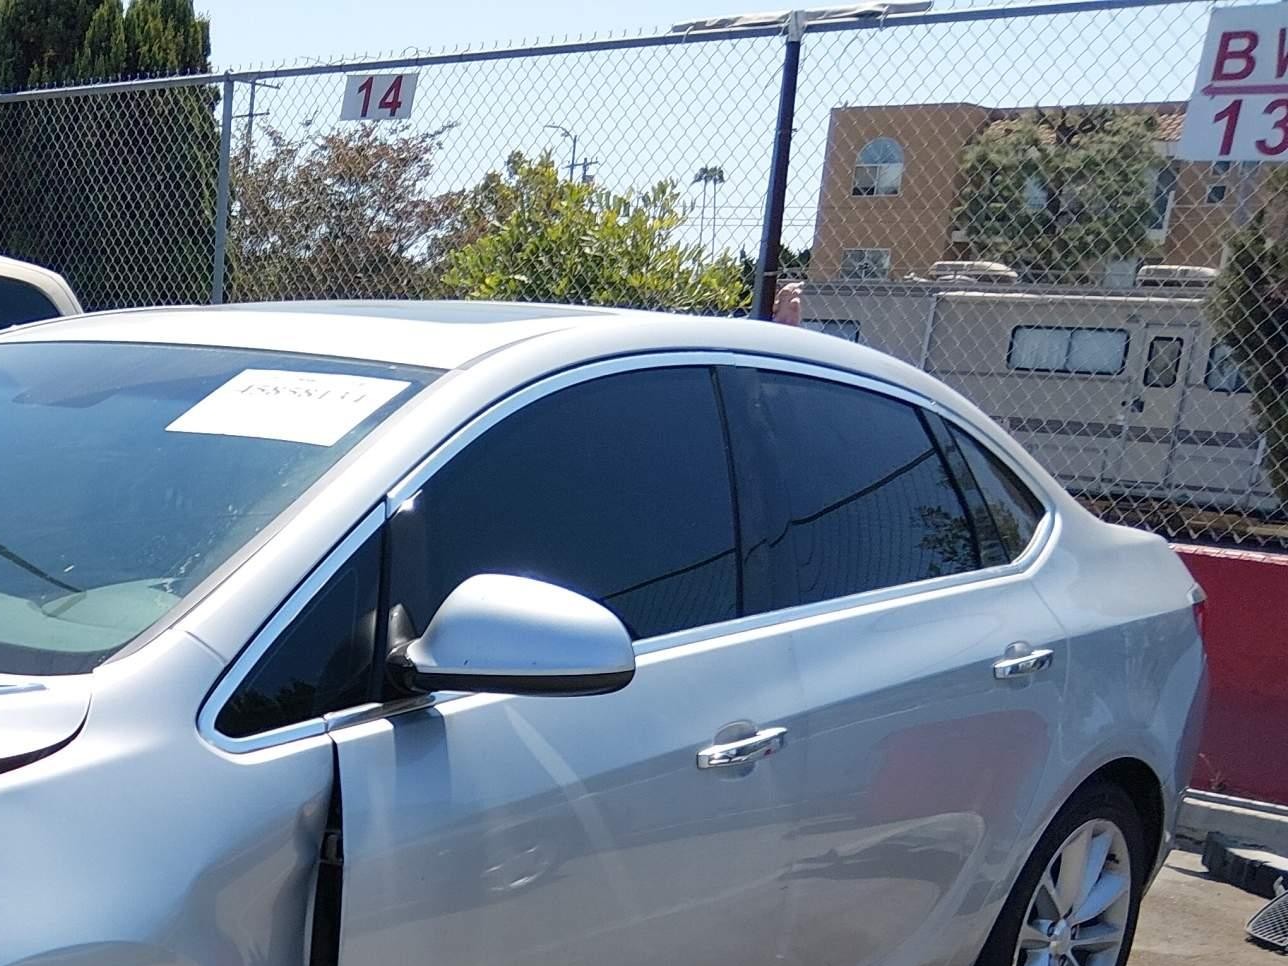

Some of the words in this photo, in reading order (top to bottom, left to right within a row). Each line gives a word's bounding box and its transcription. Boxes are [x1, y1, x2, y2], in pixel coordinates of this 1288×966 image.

[1212, 28, 1288, 81] B
[357, 75, 403, 117] 14
[1213, 98, 1288, 156] 13
